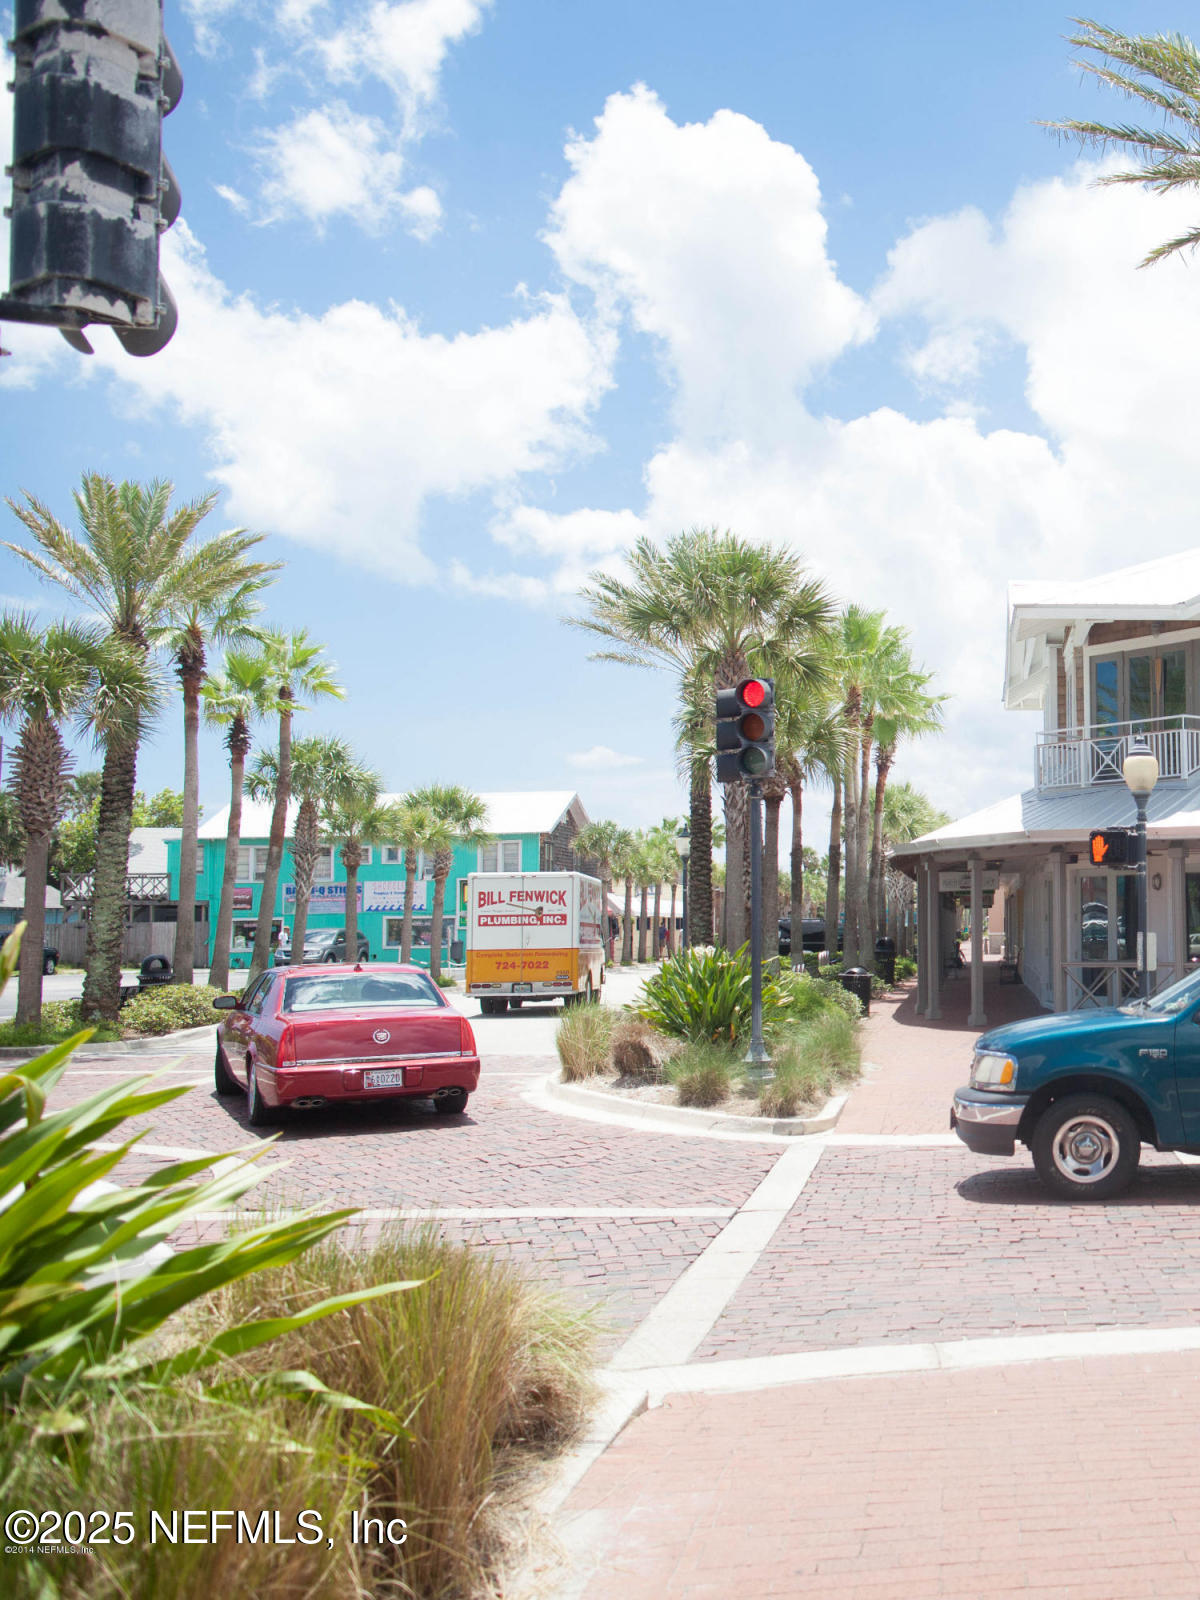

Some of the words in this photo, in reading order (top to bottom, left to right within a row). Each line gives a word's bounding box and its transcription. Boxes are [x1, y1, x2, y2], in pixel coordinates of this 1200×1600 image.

[327, 885, 362, 895] STICS
[478, 891, 505, 908] BILL
[509, 890, 567, 907] FENWICK
[542, 915, 566, 924] INC.
[495, 961, 549, 970] 724-7022
